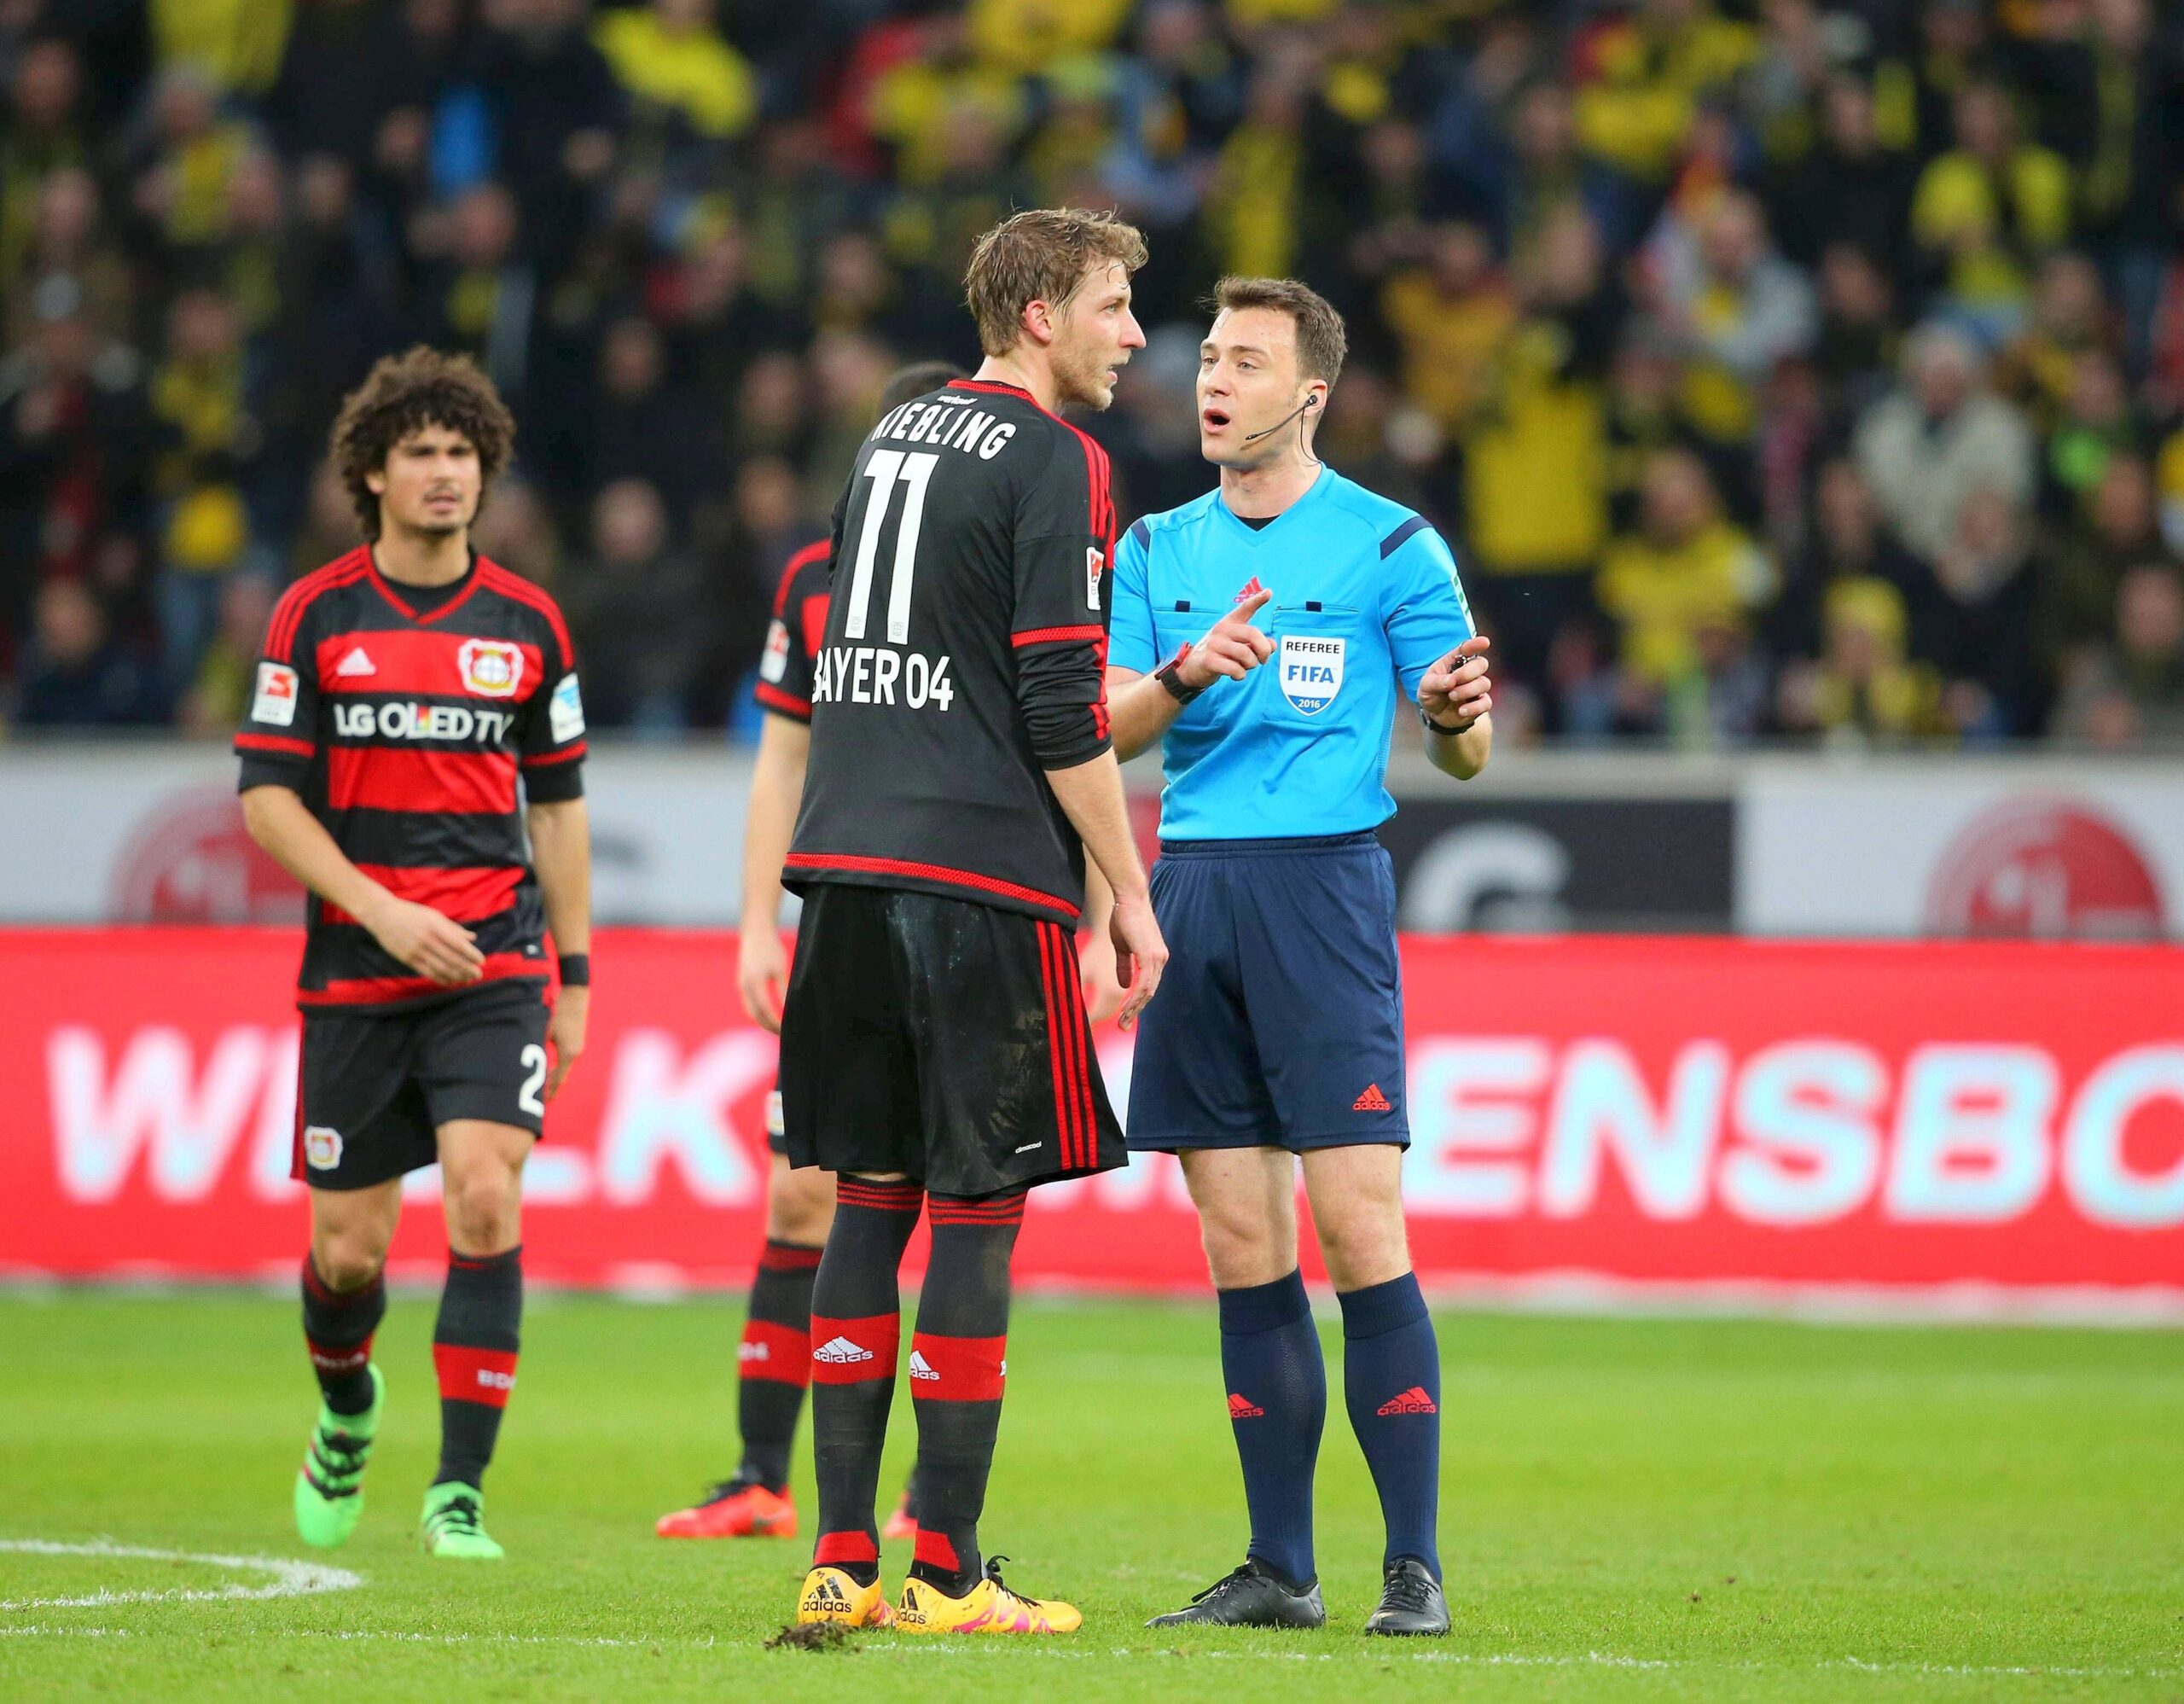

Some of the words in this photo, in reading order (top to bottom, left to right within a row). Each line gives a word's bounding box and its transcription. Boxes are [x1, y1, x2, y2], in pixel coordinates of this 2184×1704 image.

[845, 449, 939, 645] 11
[1287, 642, 1340, 654] REFEREE
[1287, 665, 1334, 683] FIFA
[905, 653, 955, 712] 04
[1298, 700, 1321, 708] 2016
[334, 703, 376, 737] LG
[377, 701, 473, 741] OLED
[474, 709, 514, 744] TV
[519, 1044, 547, 1118] 2
[1352, 1101, 1391, 1111] adidas
[813, 1350, 874, 1364] adidas
[1377, 1403, 1437, 1416] adidas
[803, 1599, 851, 1613] adidas
